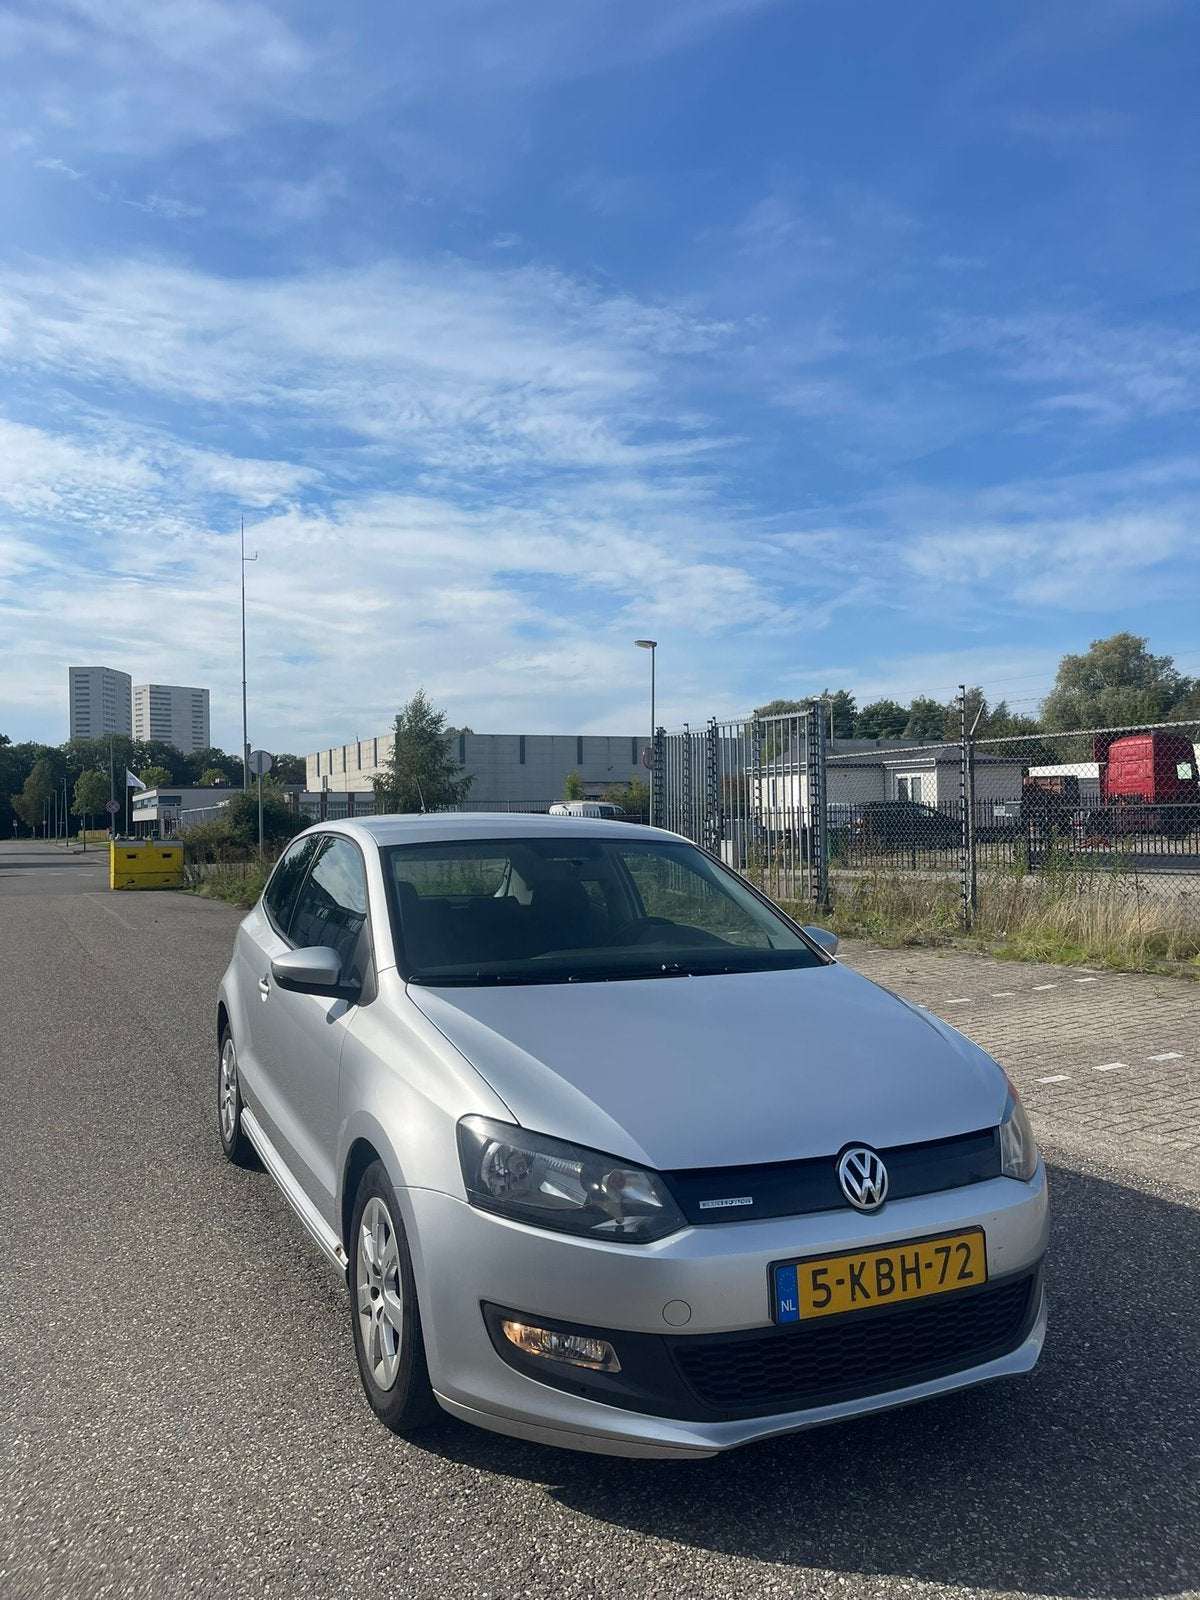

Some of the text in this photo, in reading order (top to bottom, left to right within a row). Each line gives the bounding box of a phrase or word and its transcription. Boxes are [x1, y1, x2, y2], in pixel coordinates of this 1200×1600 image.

[839, 1148, 888, 1210] VW
[780, 1298, 797, 1313] NL
[811, 1242, 974, 1308] 5-KBH-72
